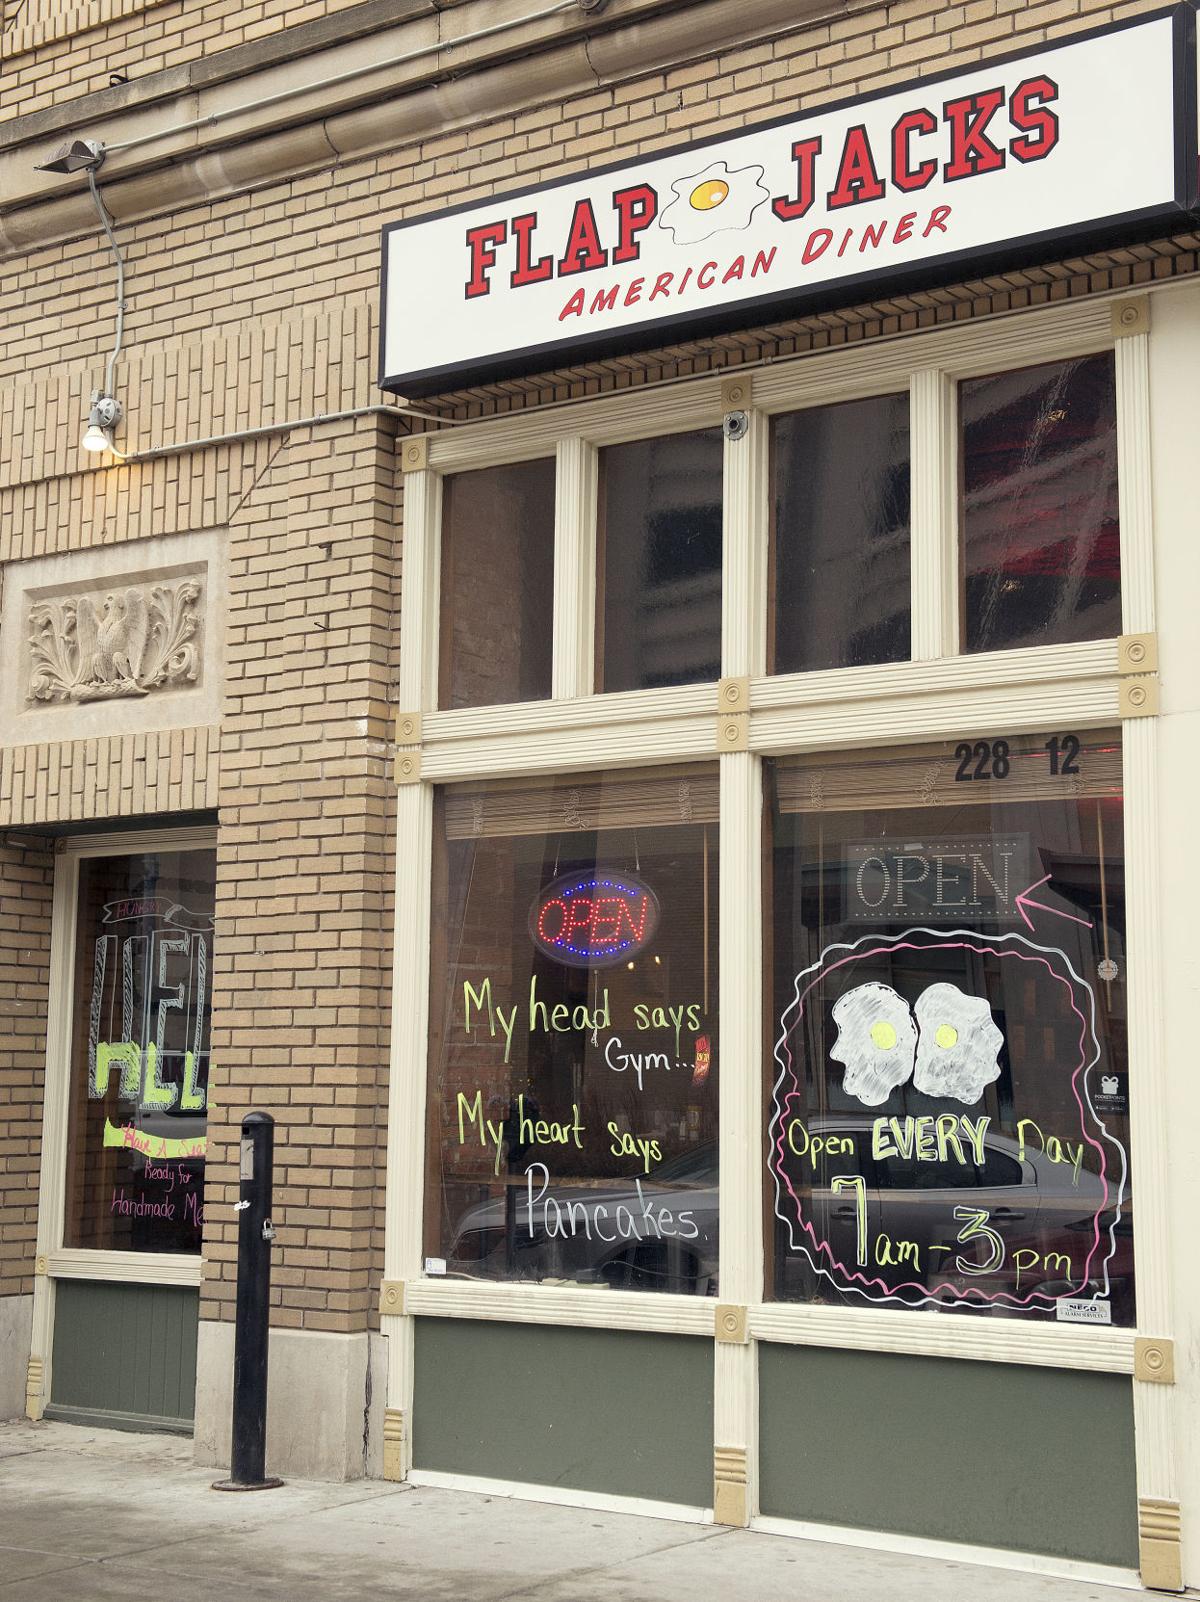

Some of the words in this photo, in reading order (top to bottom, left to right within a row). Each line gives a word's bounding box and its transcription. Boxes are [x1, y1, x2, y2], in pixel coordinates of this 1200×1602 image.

[464, 182, 659, 300] FLAP
[771, 74, 1060, 222] JACKS
[558, 246, 779, 321] AMERICAN
[801, 205, 953, 266] DINER
[954, 740, 1010, 781] 228
[1045, 735, 1081, 776] 12
[855, 852, 1013, 908] OPEN
[537, 895, 648, 943] OPEN
[88, 929, 208, 1110] HEL
[463, 976, 518, 1064] My
[529, 974, 612, 1033] head
[633, 1003, 701, 1058] says
[457, 1090, 504, 1177] My
[518, 1093, 586, 1149] heart
[787, 1118, 855, 1170] Open
[871, 1113, 992, 1167] EVERY
[1016, 1118, 1085, 1187] Day
[110, 1187, 176, 1221] Handmade
[183, 1192, 207, 1228] Me
[144, 1156, 175, 1193] Ready
[178, 1163, 193, 1185] for
